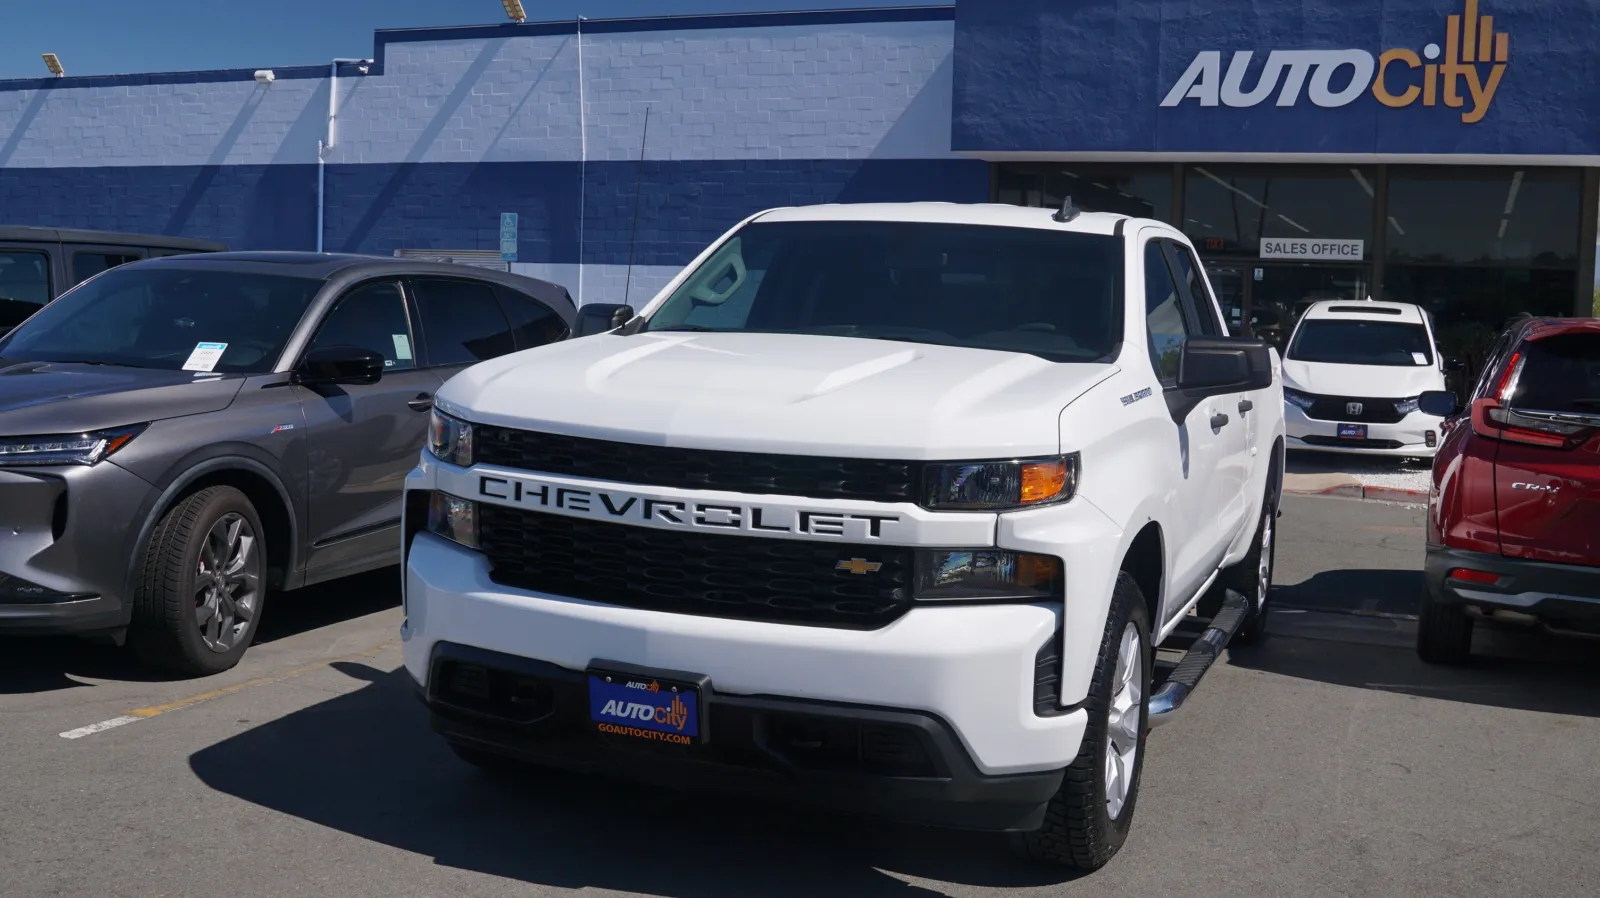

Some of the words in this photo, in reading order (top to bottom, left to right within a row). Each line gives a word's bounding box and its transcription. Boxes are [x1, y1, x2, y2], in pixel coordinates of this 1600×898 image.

[1265, 242, 1307, 254] SALES
[1311, 243, 1359, 256] OFFICE
[1511, 482, 1560, 493] CR-V
[479, 475, 900, 539] CHEVROLET
[598, 723, 691, 745] GOAUTOCITY.COM
